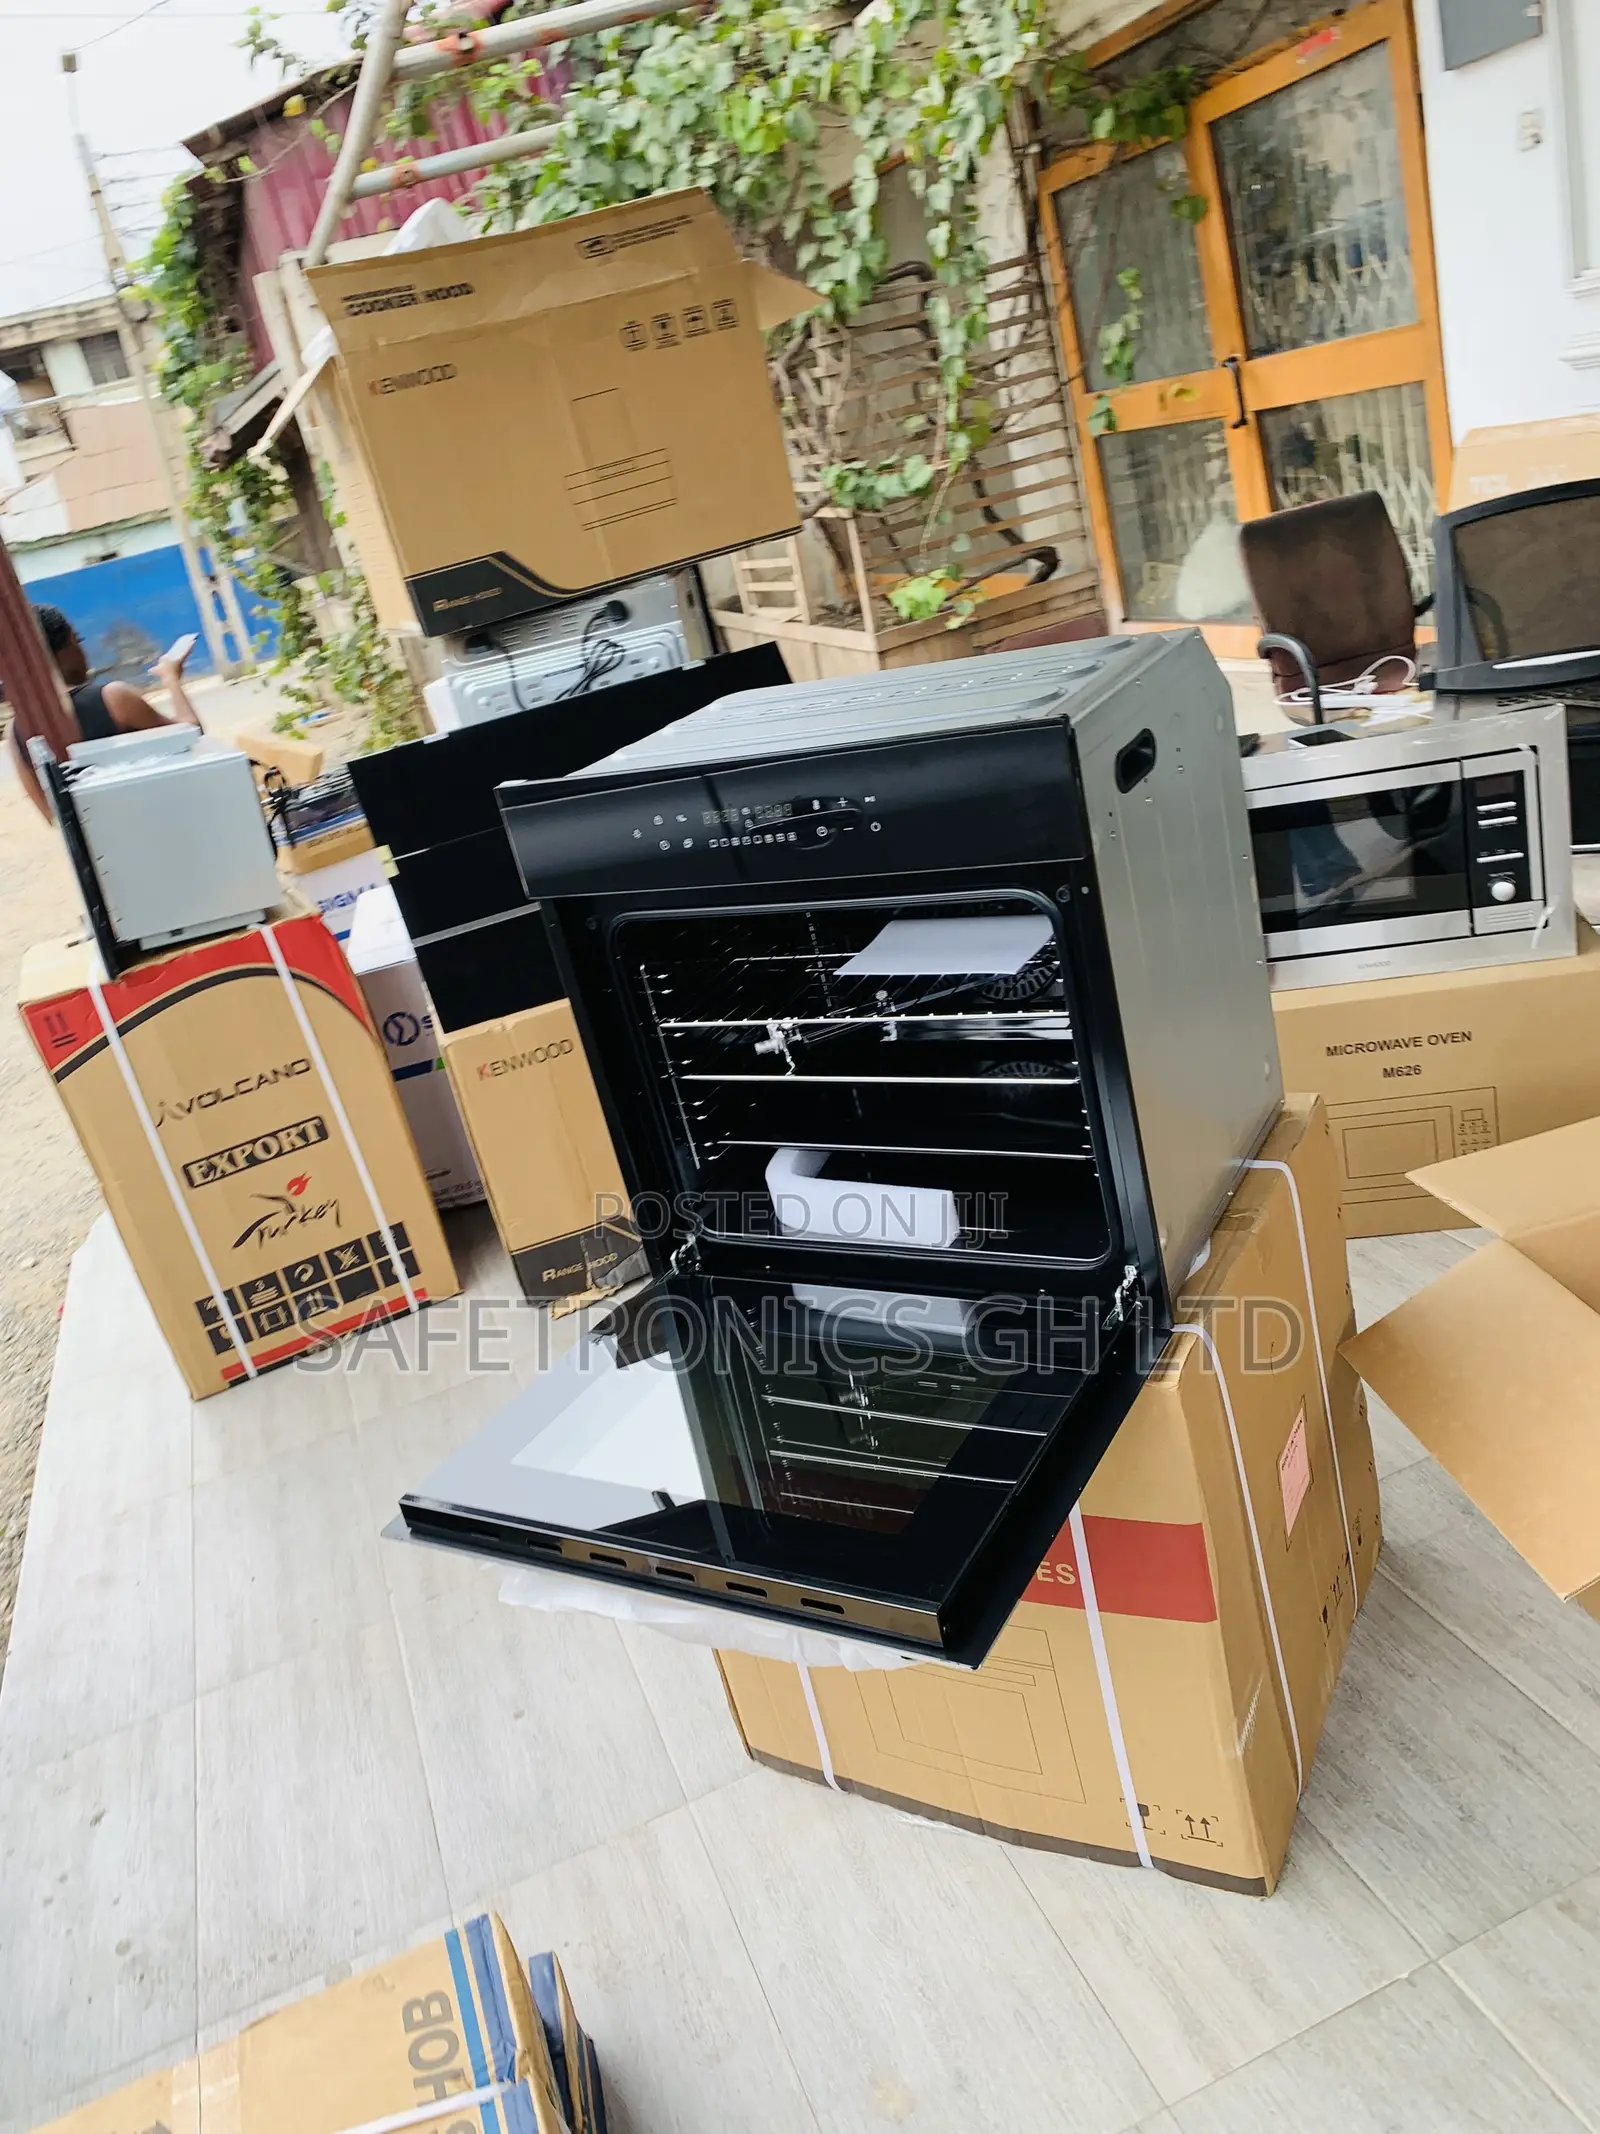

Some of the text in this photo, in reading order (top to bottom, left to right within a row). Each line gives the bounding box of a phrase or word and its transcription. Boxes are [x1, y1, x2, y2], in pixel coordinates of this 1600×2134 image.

[476, 1038, 574, 1081] KENWOOD
[1326, 1030, 1473, 1057] MICROWAVE OVEN
[176, 1057, 311, 1114] VOLCANO
[1382, 1064, 1423, 1079] M626
[186, 1117, 325, 1187] EXPORT
[402, 1989, 465, 2108] HOB
